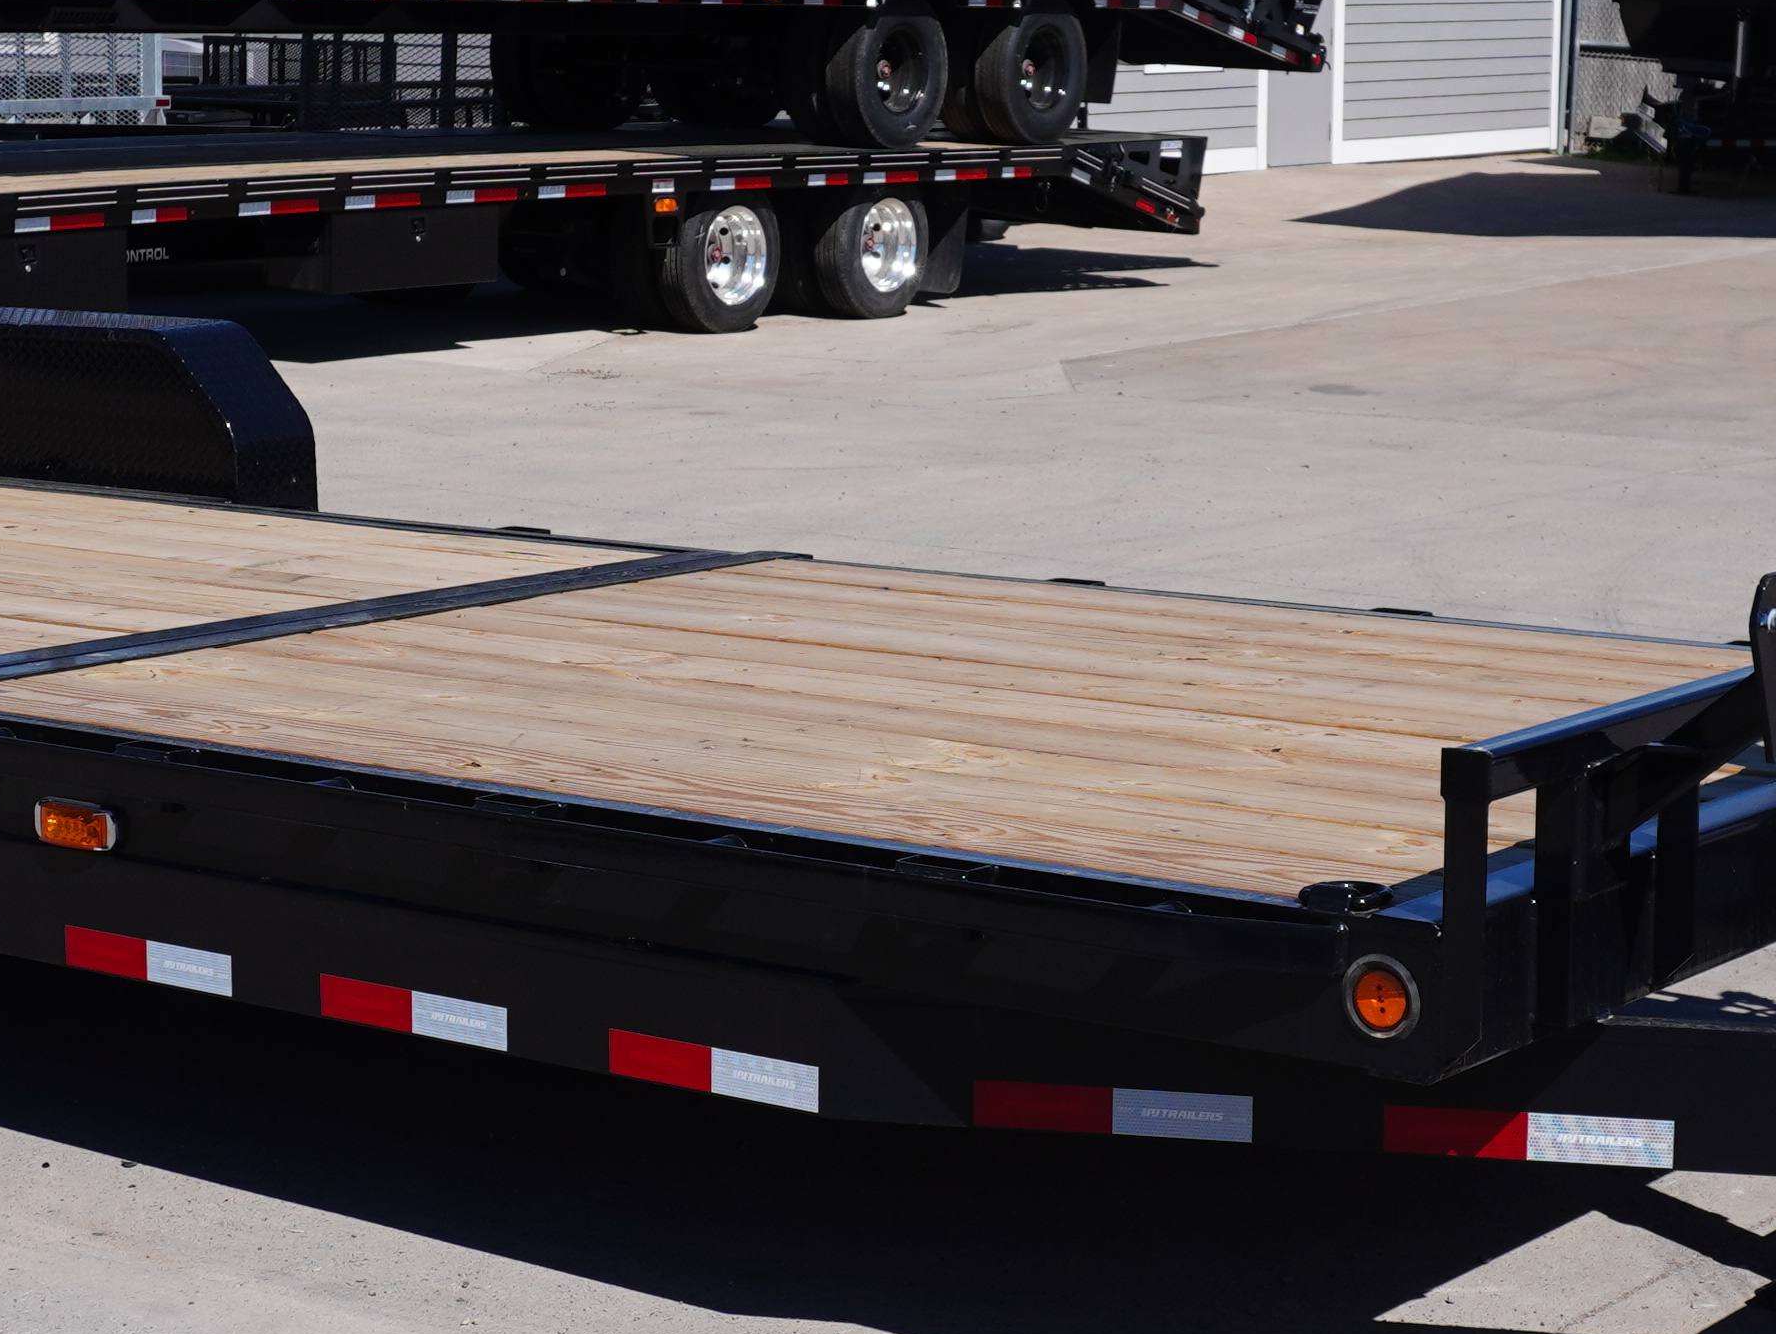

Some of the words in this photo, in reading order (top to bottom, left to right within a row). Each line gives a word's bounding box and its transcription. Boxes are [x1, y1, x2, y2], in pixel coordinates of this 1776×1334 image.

[747, 1072, 796, 1089] TRAILERS
[1160, 1109, 1224, 1121] TRAILERS
[1576, 1134, 1644, 1147] TRAILERS
